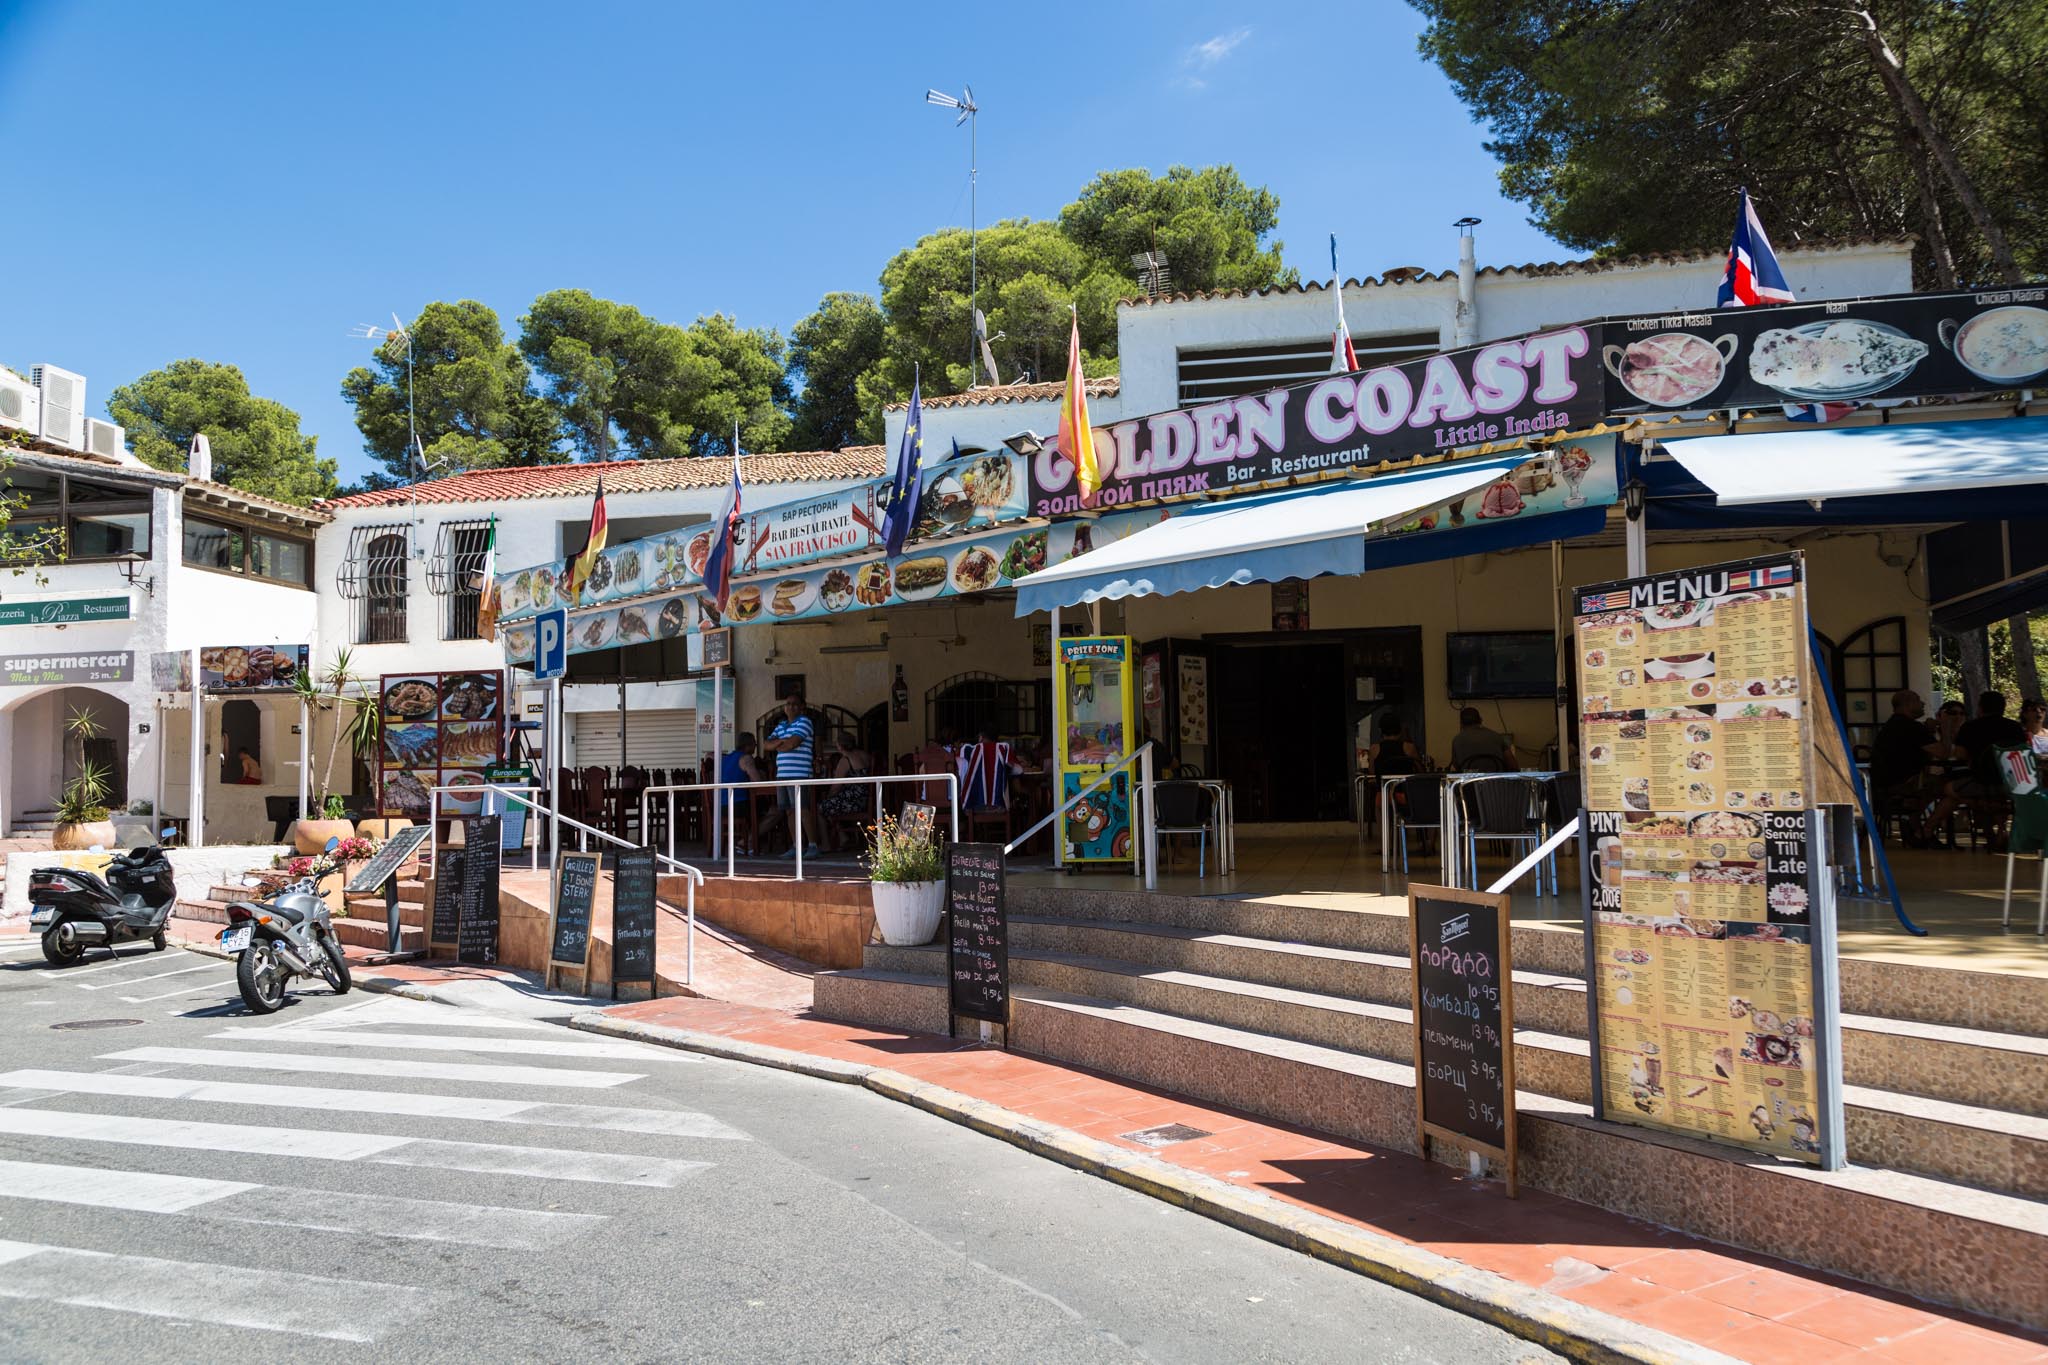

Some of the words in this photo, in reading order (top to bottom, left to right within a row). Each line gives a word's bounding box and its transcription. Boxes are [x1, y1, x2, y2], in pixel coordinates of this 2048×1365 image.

[1976, 292, 2010, 305] Chicken
[2012, 290, 2045, 302] Madras
[1826, 302, 1848, 314] Naan
[1627, 318, 1658, 331] Chicken
[1660, 316, 1682, 329] Tikka
[1683, 314, 1712, 328] Masala
[1305, 328, 1590, 443] COAST
[1434, 422, 1499, 449] Little
[1504, 410, 1570, 437] India
[1227, 463, 1256, 482] Bar
[1272, 443, 1371, 475] Restaurant
[782, 510, 797, 522] БАР
[799, 499, 838, 519] РЕСТОРАН
[771, 528, 788, 543] BAR
[790, 515, 850, 538] RESTAURANTE
[766, 545, 787, 562] SAN
[790, 529, 857, 557] FRANCISCO
[1629, 572, 1729, 609] MENU
[31, 613, 39, 623] la
[41, 601, 80, 623] Piazza
[84, 603, 128, 614] Restaurant
[539, 618, 558, 673] P
[1067, 645, 1093, 656] PRIZE
[1096, 645, 1119, 654] ZONE
[4, 653, 128, 673] supermercat
[10, 673, 32, 682] Mar
[33, 675, 39, 684] y
[42, 672, 64, 681] Mar
[90, 672, 100, 680] 25
[547, 668, 563, 677] MOTOS
[492, 769, 524, 777] Europcar
[1589, 812, 1622, 832] PINT
[1763, 812, 1806, 829] Food
[1765, 829, 1807, 842] Serving
[1774, 841, 1799, 855] Till
[1767, 856, 1807, 873] Late
[1592, 888, 1621, 910] 2,00€
